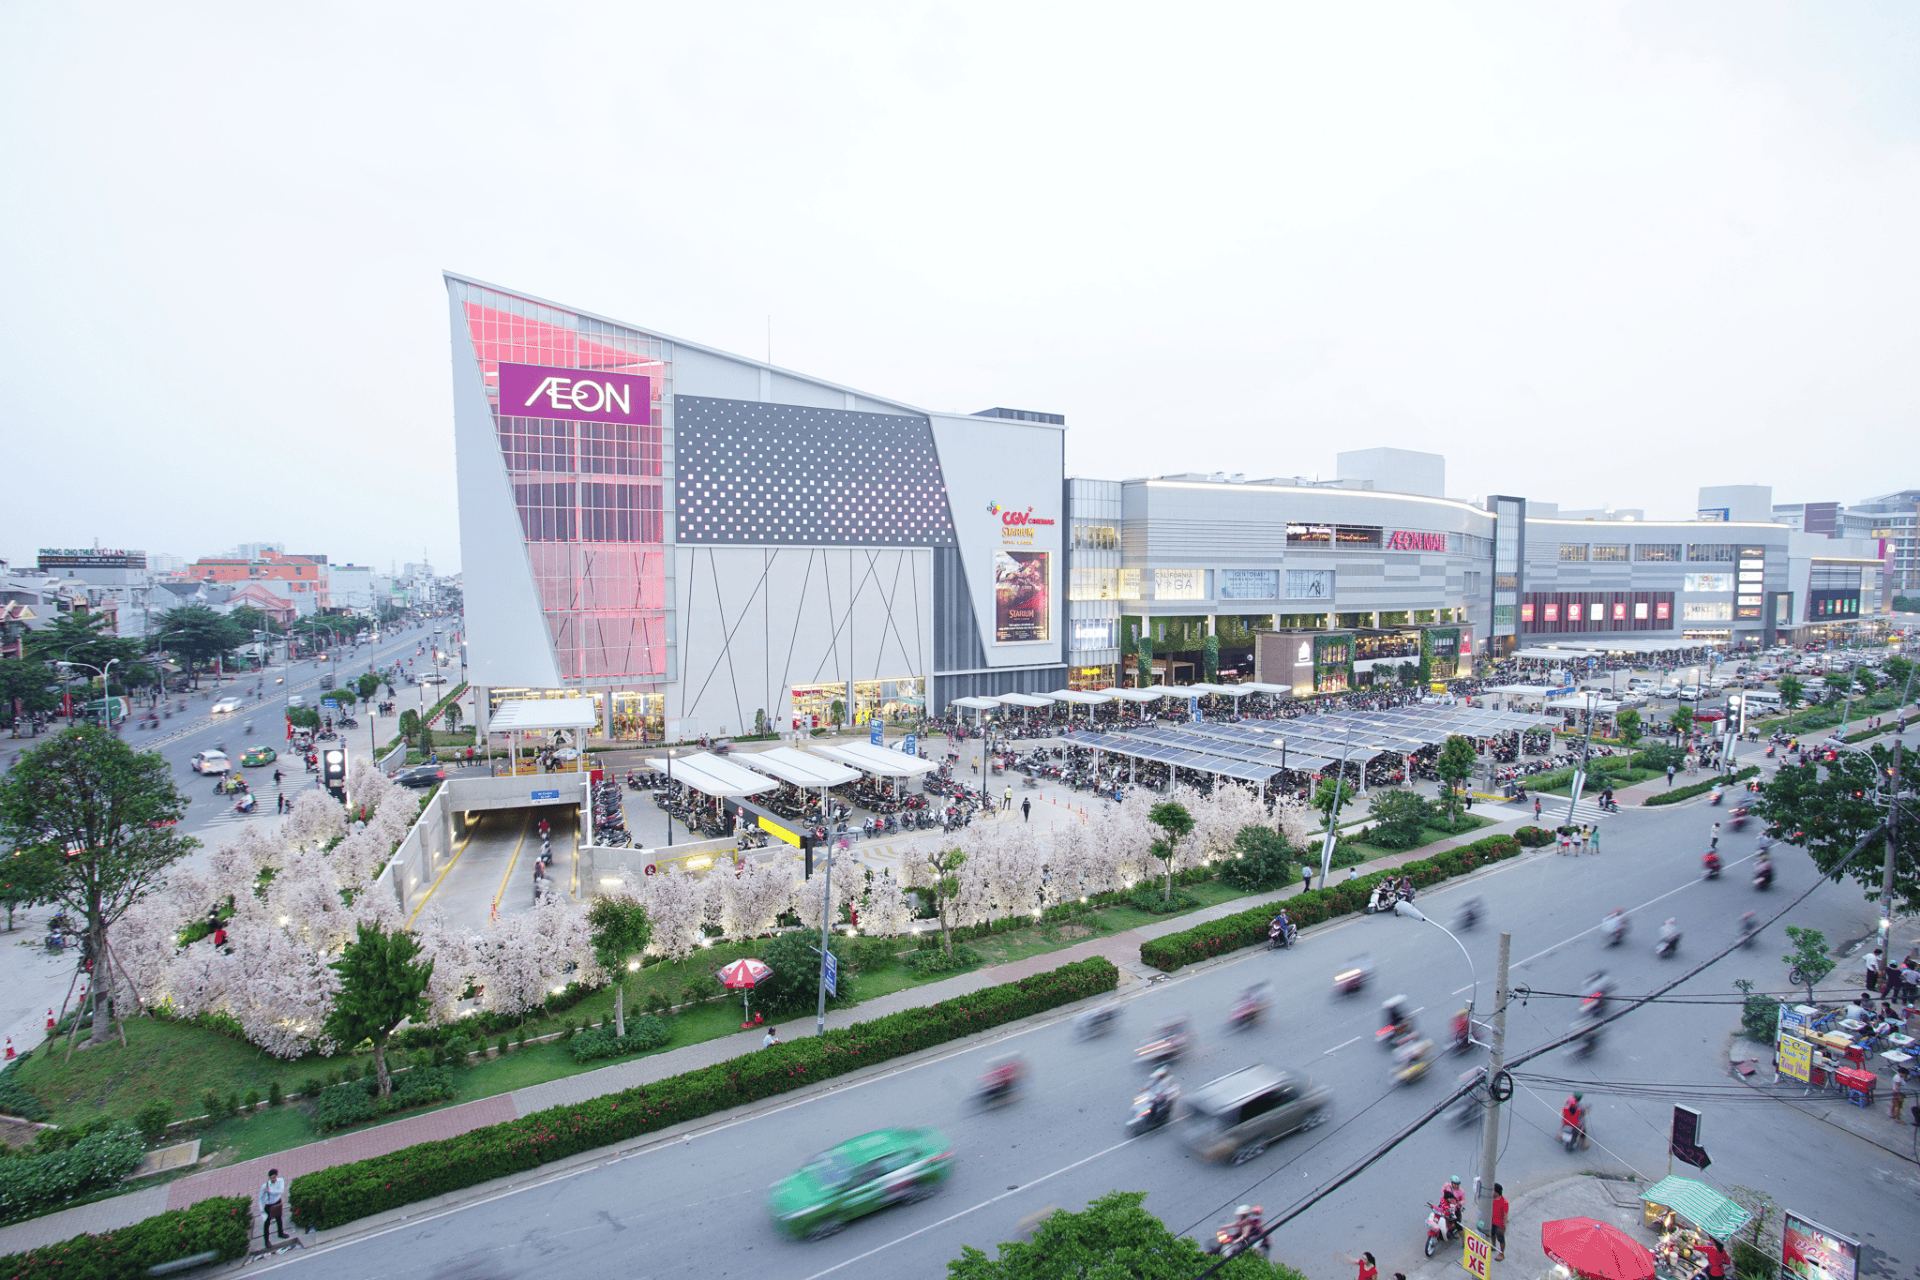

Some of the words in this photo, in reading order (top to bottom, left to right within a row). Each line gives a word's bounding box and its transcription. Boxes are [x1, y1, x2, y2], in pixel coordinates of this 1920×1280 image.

[1002, 511, 1029, 525] CGV
[1002, 526, 1034, 538] STARIUM
[1423, 532, 1448, 552] MALL
[1467, 1235, 1489, 1260] GIỮ
[1468, 1255, 1485, 1276] XE
